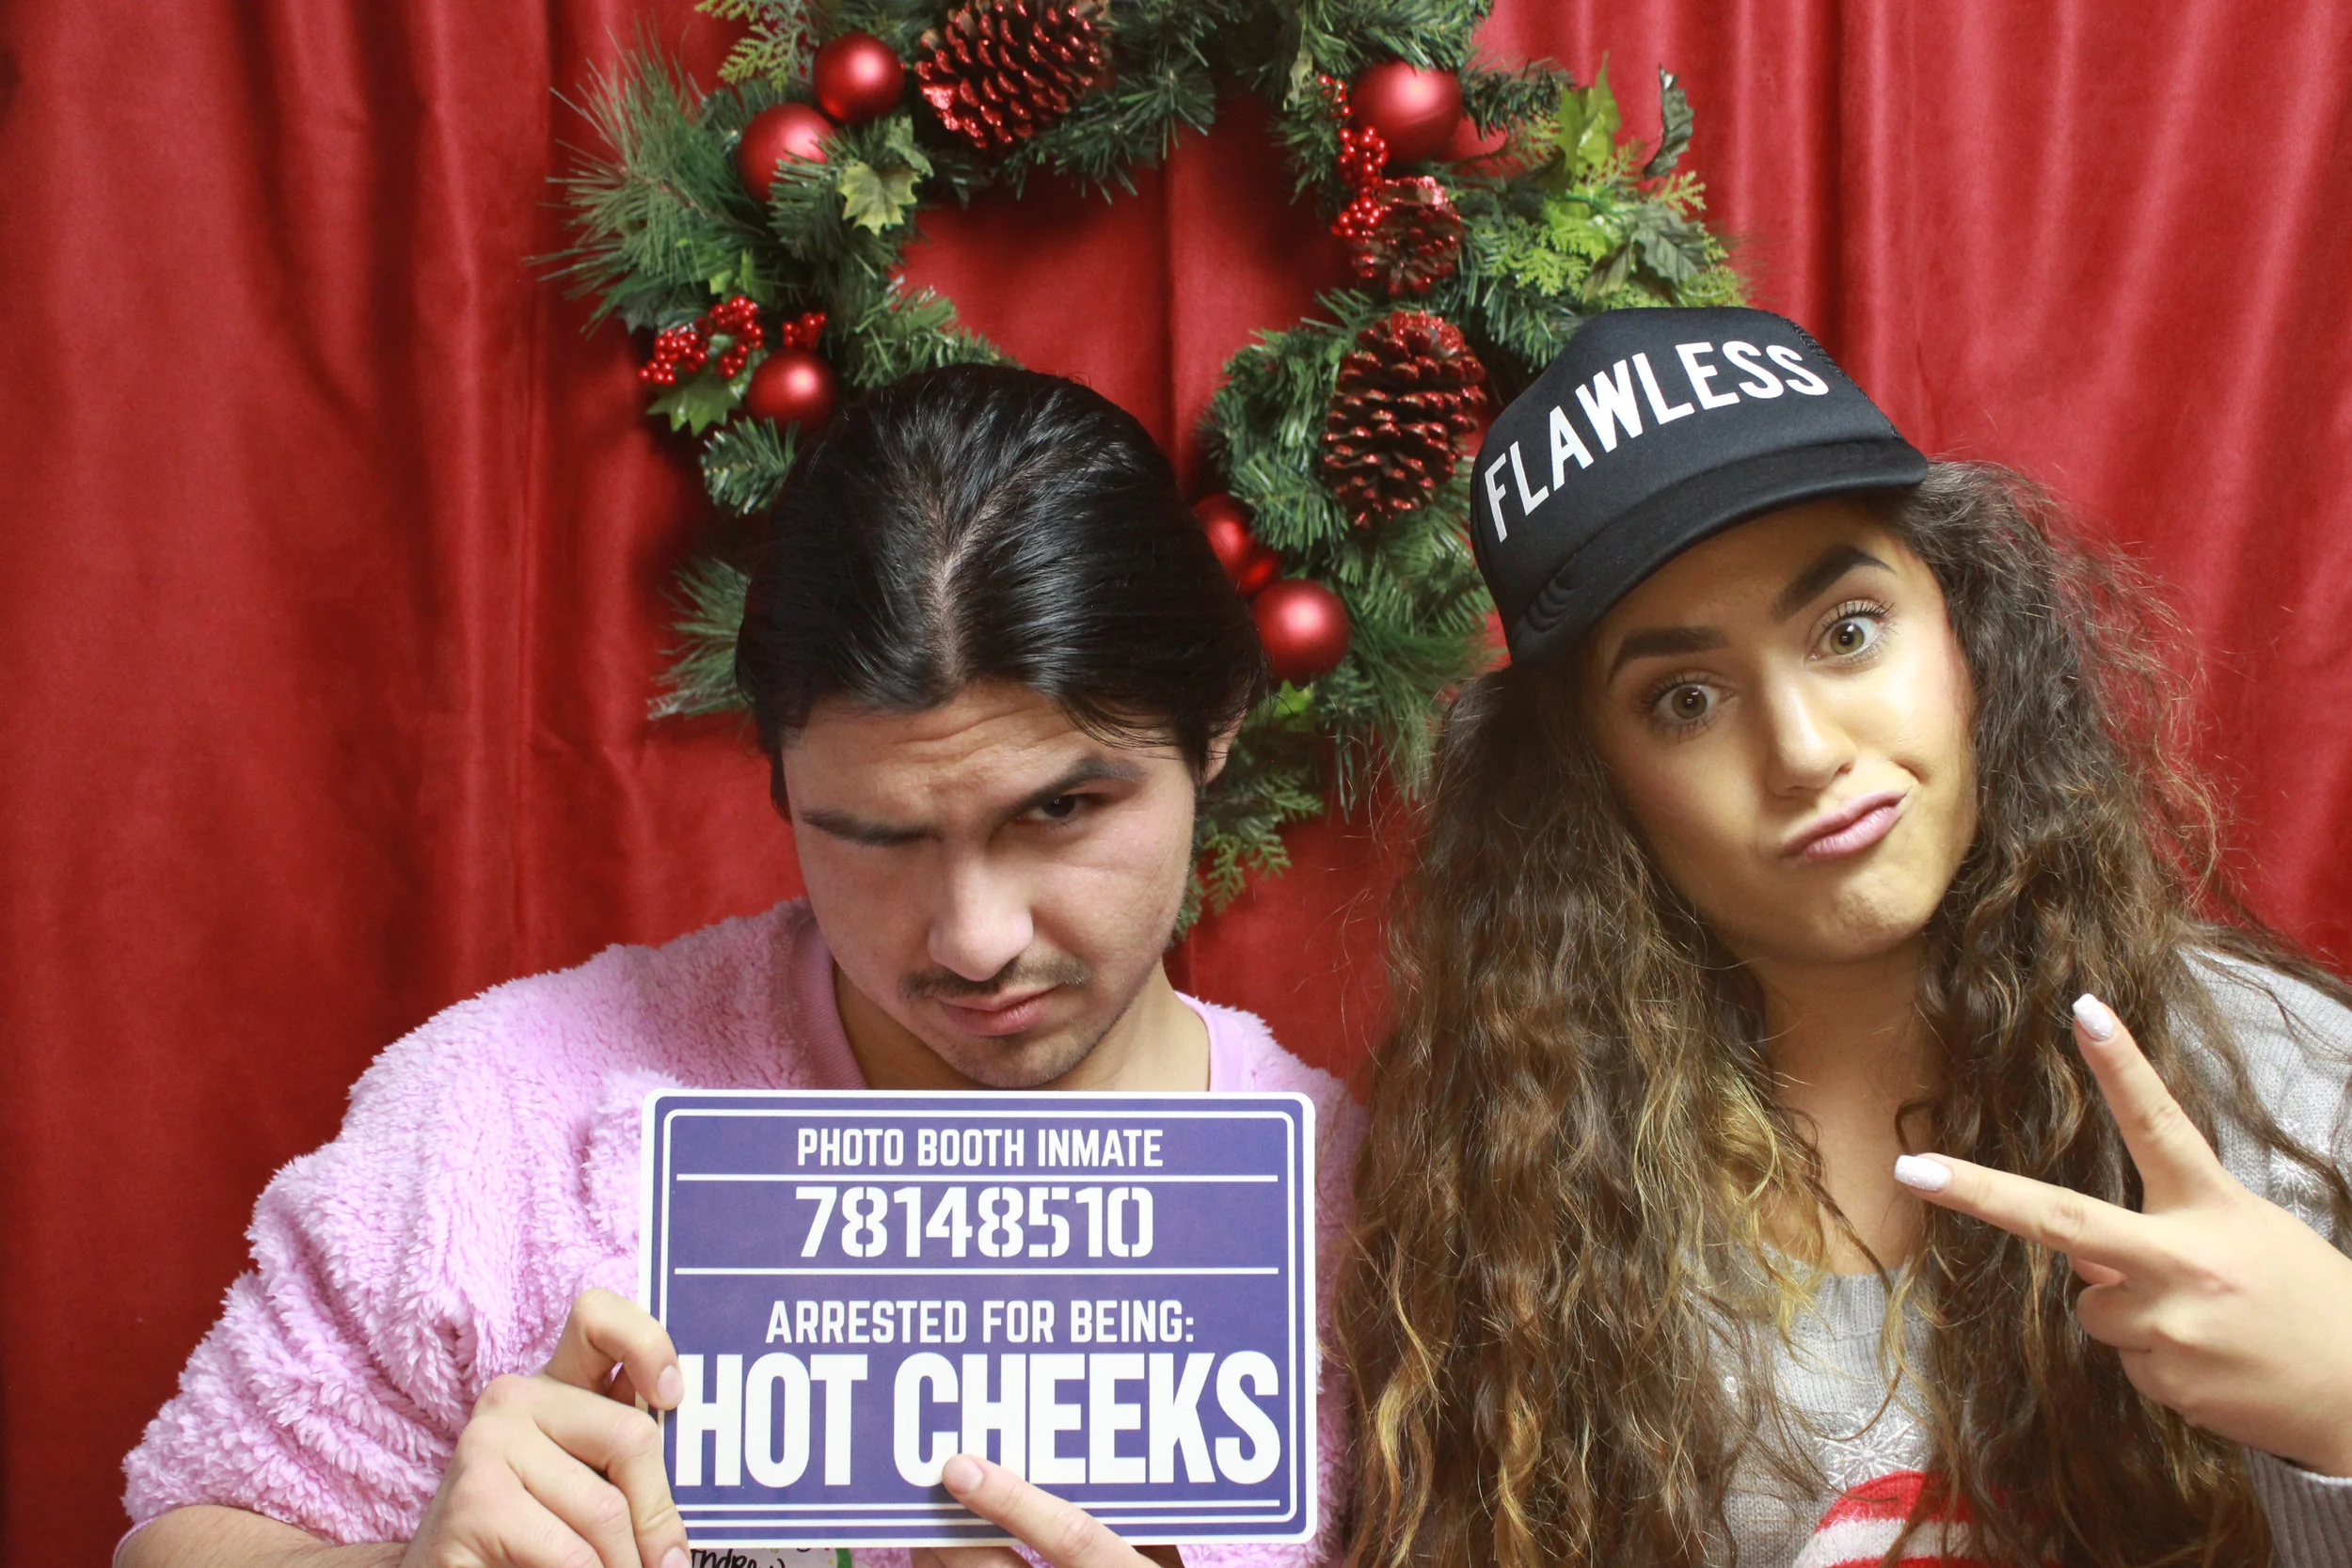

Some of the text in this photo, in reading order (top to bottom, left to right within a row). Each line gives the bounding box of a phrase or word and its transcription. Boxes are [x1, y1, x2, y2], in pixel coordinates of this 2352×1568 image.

[1484, 340, 1830, 544] FLAWLESS
[797, 1128, 1164, 1167] PHOTO BOOTH INMATE
[795, 1186, 1154, 1259] 78148510
[765, 1299, 1195, 1344] ARRESTED FOR BEING:
[675, 1350, 1281, 1489] HOT CHEEKS
